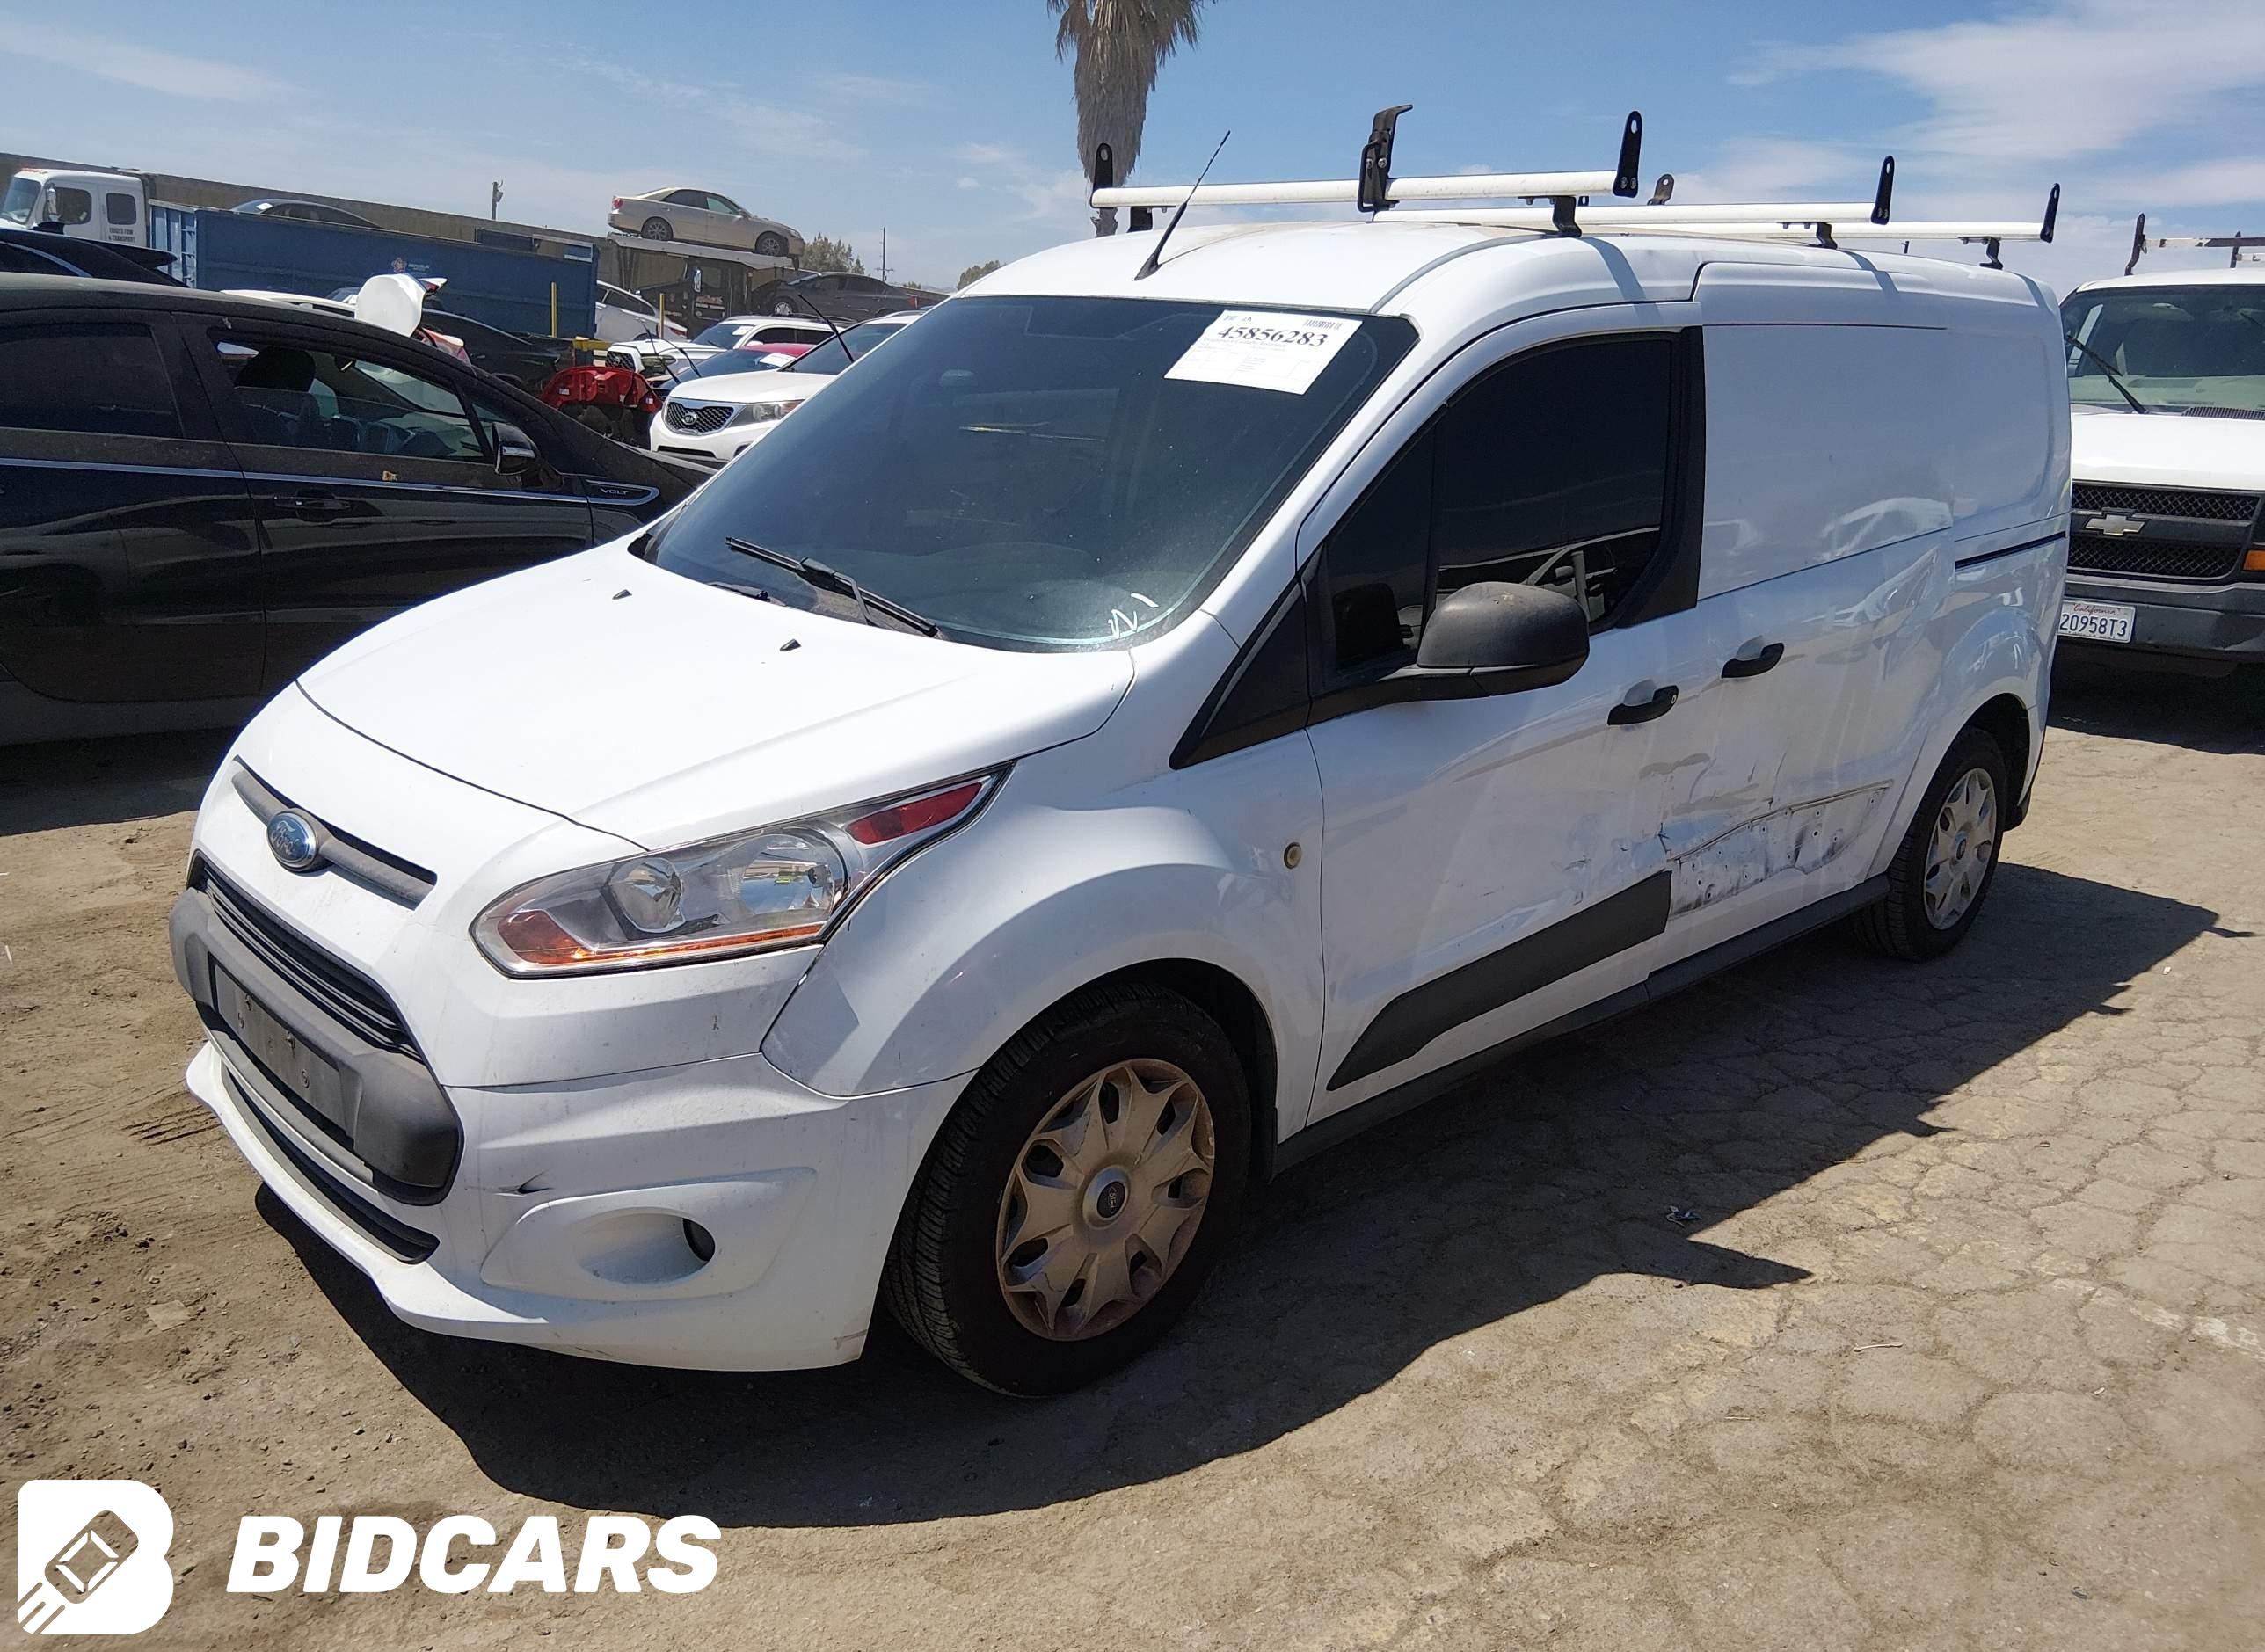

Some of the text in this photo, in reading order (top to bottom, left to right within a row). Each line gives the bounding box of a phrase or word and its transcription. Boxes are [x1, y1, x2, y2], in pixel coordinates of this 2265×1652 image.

[1218, 325, 1329, 347] 45856283
[2072, 603, 2117, 615] California
[2059, 614, 2127, 637] 20958T3
[270, 820, 300, 856] Ford
